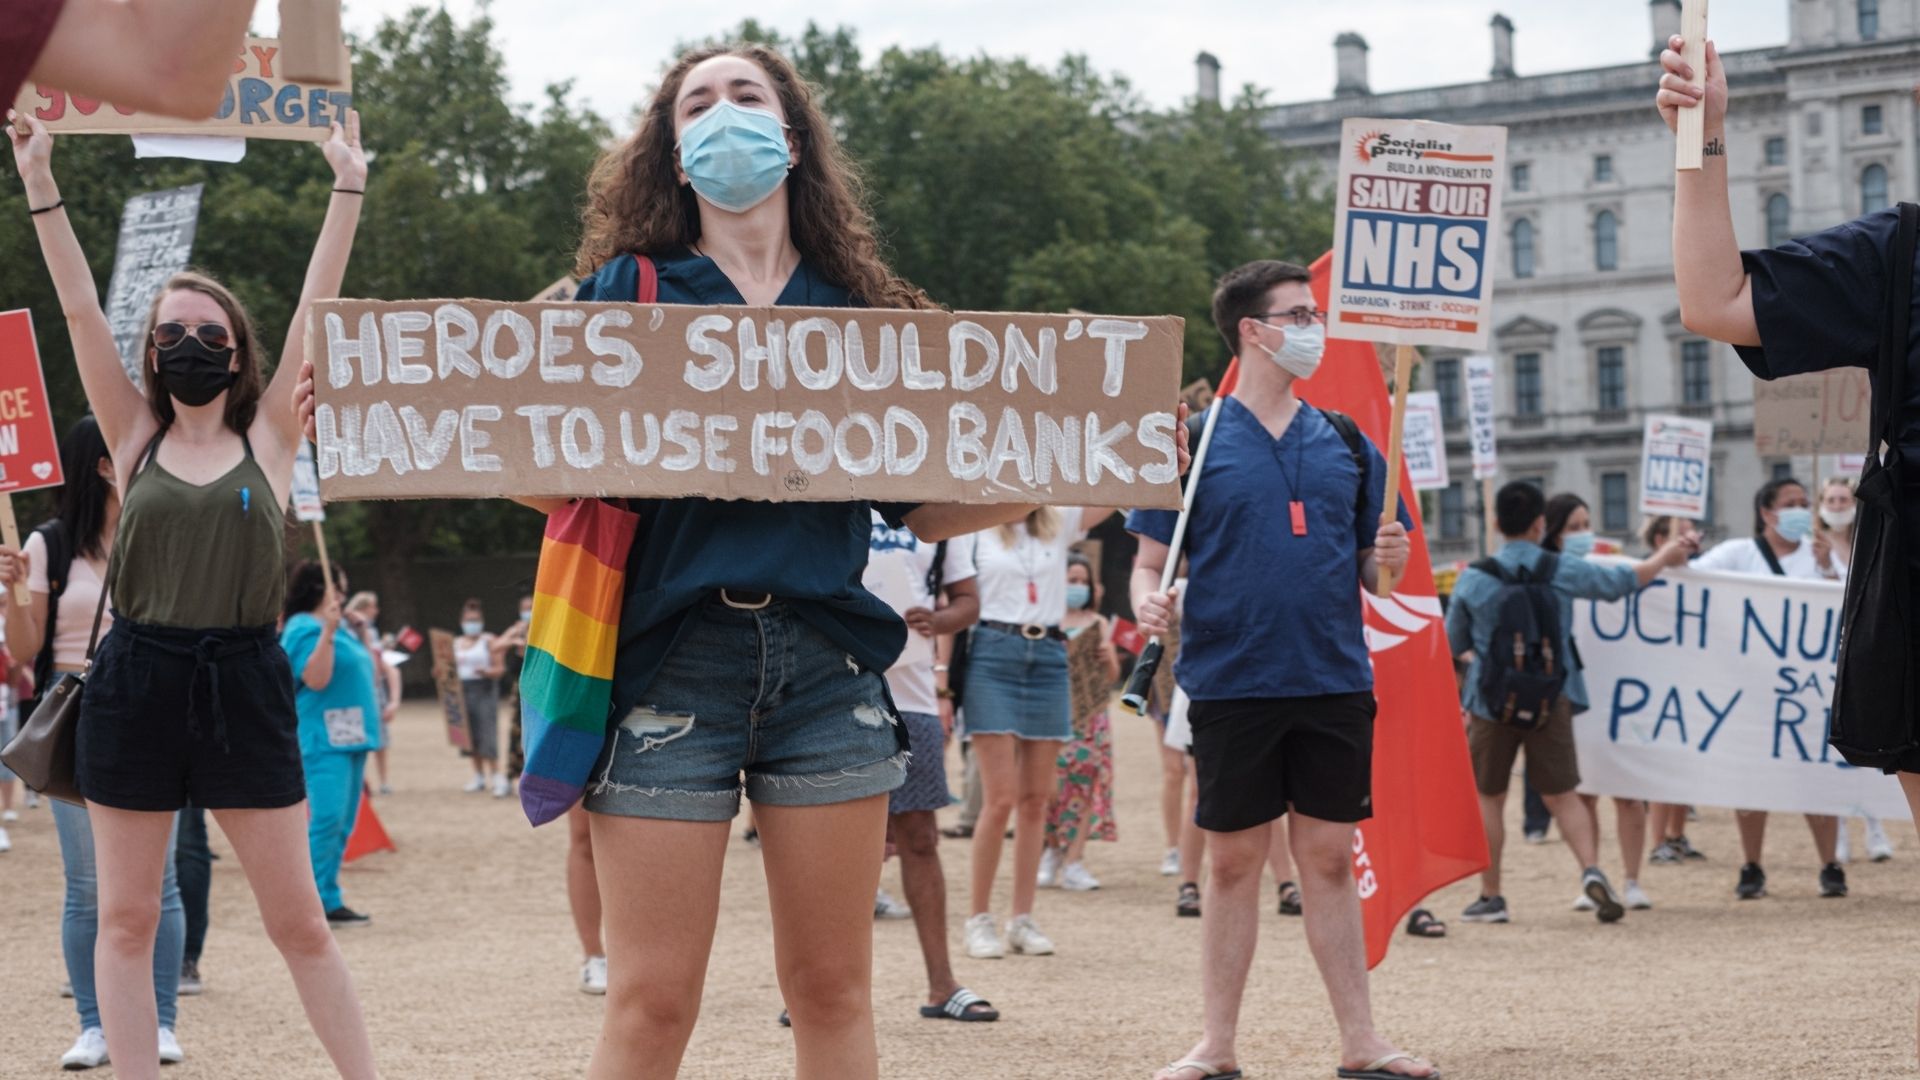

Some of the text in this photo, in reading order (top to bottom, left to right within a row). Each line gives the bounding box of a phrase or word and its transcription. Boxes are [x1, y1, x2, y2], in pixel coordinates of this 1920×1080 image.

[1378, 133, 1452, 152] Socialist
[1387, 162, 1494, 179] BUILD A MOVEMENT TO
[1352, 176, 1488, 216] SAVE OUR
[1348, 218, 1480, 292] NHS
[1340, 294, 1479, 315] CAMPAIGN STRIKE OCCUPY
[325, 304, 1149, 397] HEROES' SHOULDN'T
[316, 401, 1180, 486] HAVE TO USE FOOD BANKS
[1648, 459, 1702, 494] NHS
[1774, 667, 1837, 698] SA
[1608, 678, 1858, 770] PAY RI
[1352, 828, 1378, 899] org
